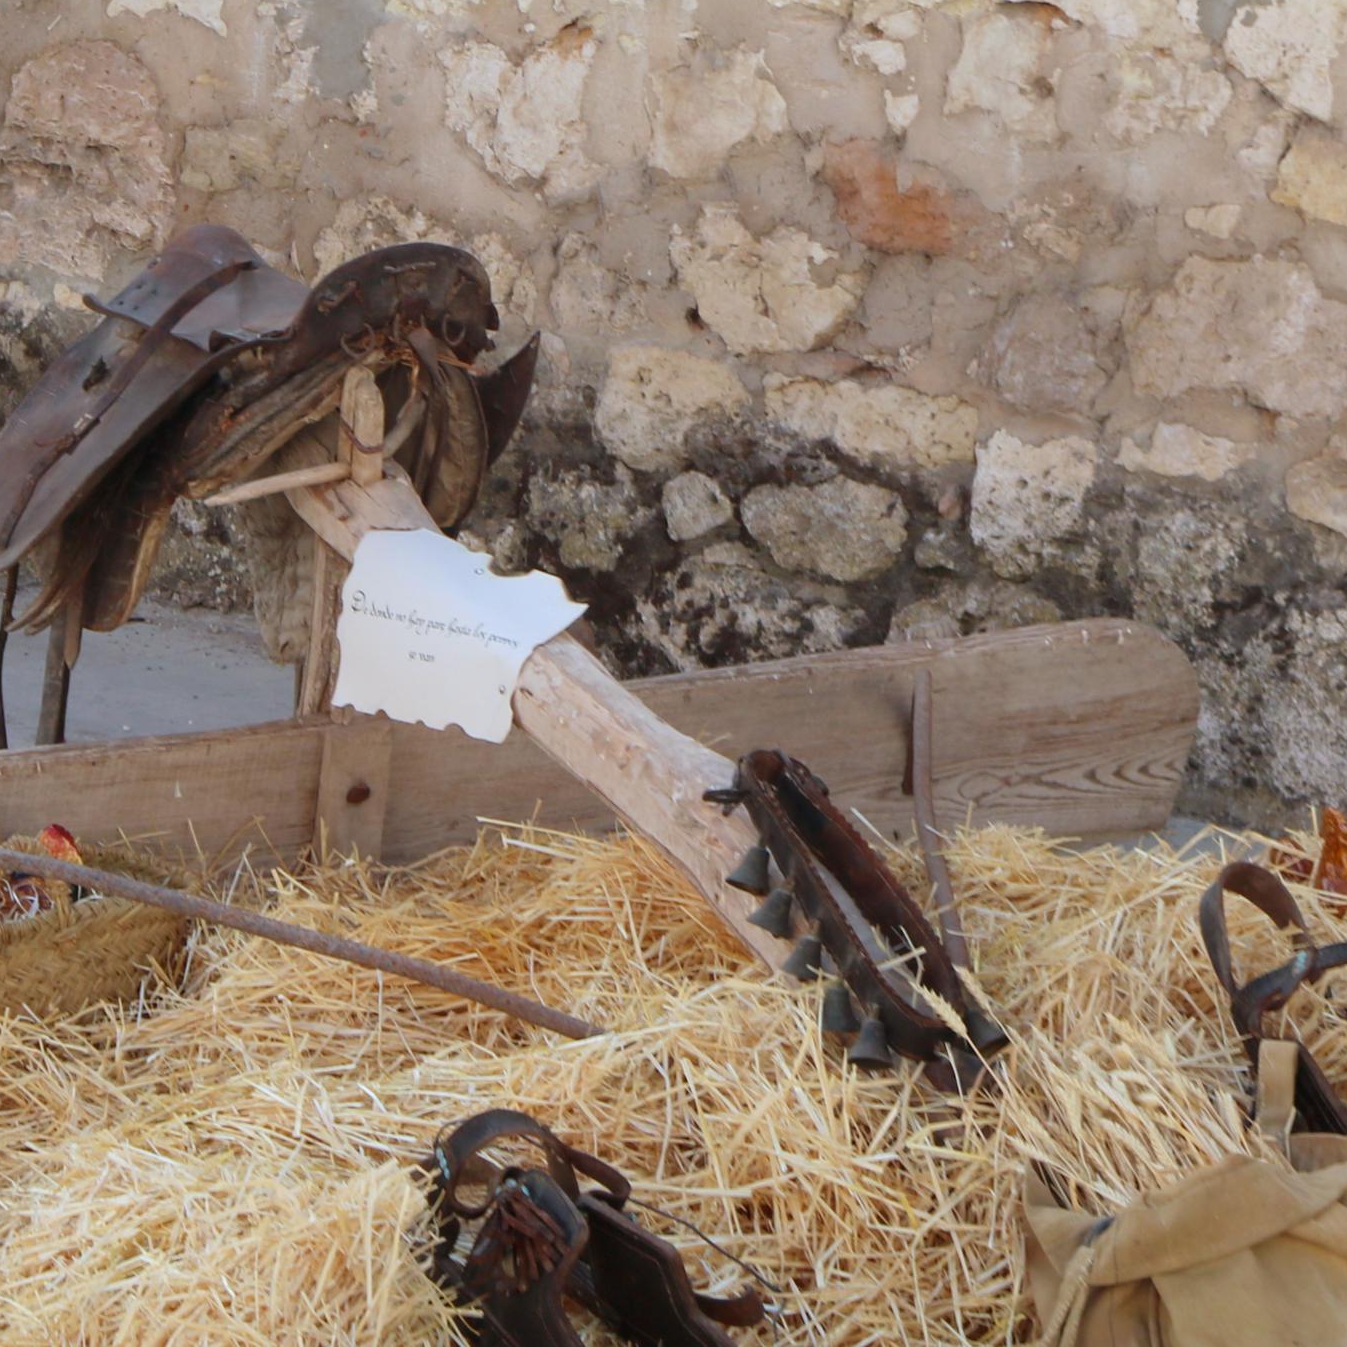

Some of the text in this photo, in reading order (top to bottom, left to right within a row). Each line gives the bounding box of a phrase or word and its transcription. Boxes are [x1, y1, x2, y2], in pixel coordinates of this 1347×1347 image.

[350, 589, 369, 614] De
[370, 600, 395, 620] donde
[395, 612, 407, 623] no
[407, 609, 425, 635] hay
[446, 617, 471, 638] hasta
